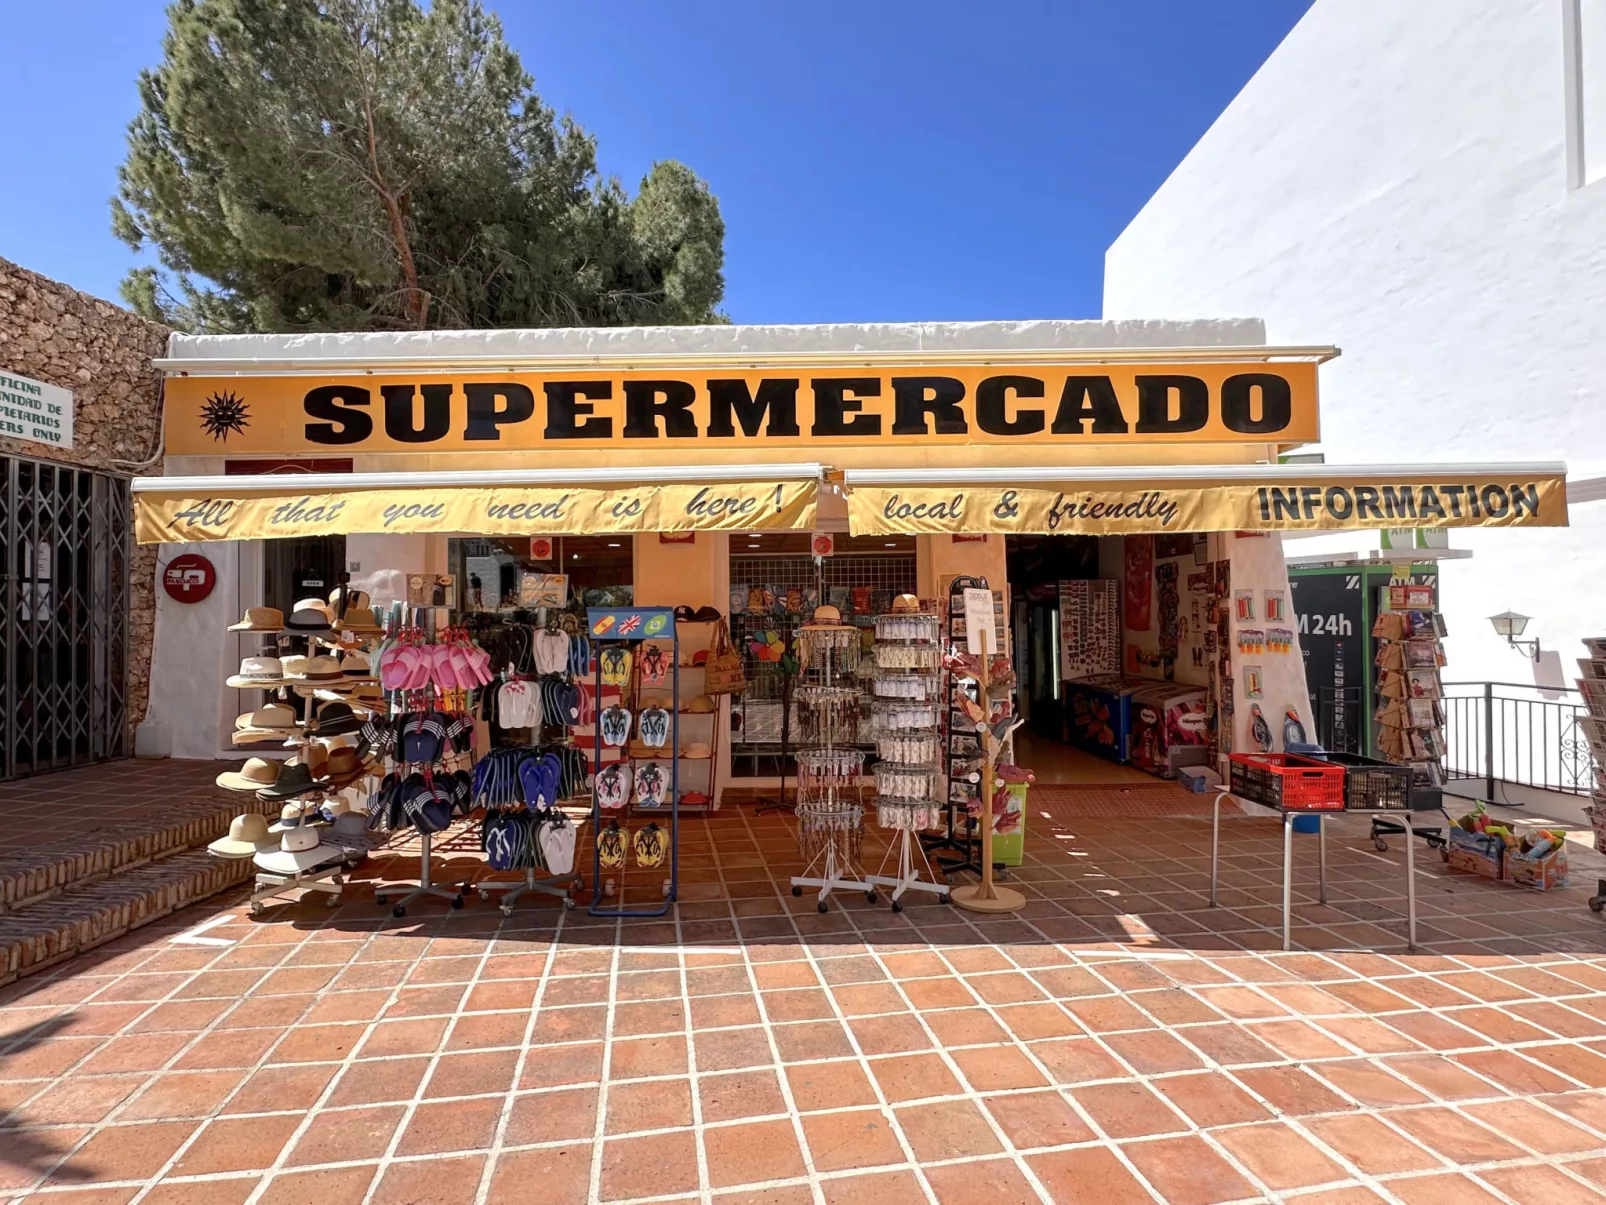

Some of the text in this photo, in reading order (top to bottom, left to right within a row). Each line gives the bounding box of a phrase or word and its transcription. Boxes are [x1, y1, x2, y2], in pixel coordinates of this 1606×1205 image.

[0, 376, 41, 395] FICINA
[0, 391, 62, 415] NIDAD DE
[304, 374, 1291, 442] SUPERMERCADO
[0, 420, 61, 442] ERS ONLY
[166, 498, 234, 528] All
[270, 496, 346, 525] that
[382, 502, 446, 527] you
[487, 494, 570, 520] need
[611, 495, 643, 518] is
[883, 484, 1539, 529] local & friendly INFORMATION
[1312, 613, 1352, 636] 24h
